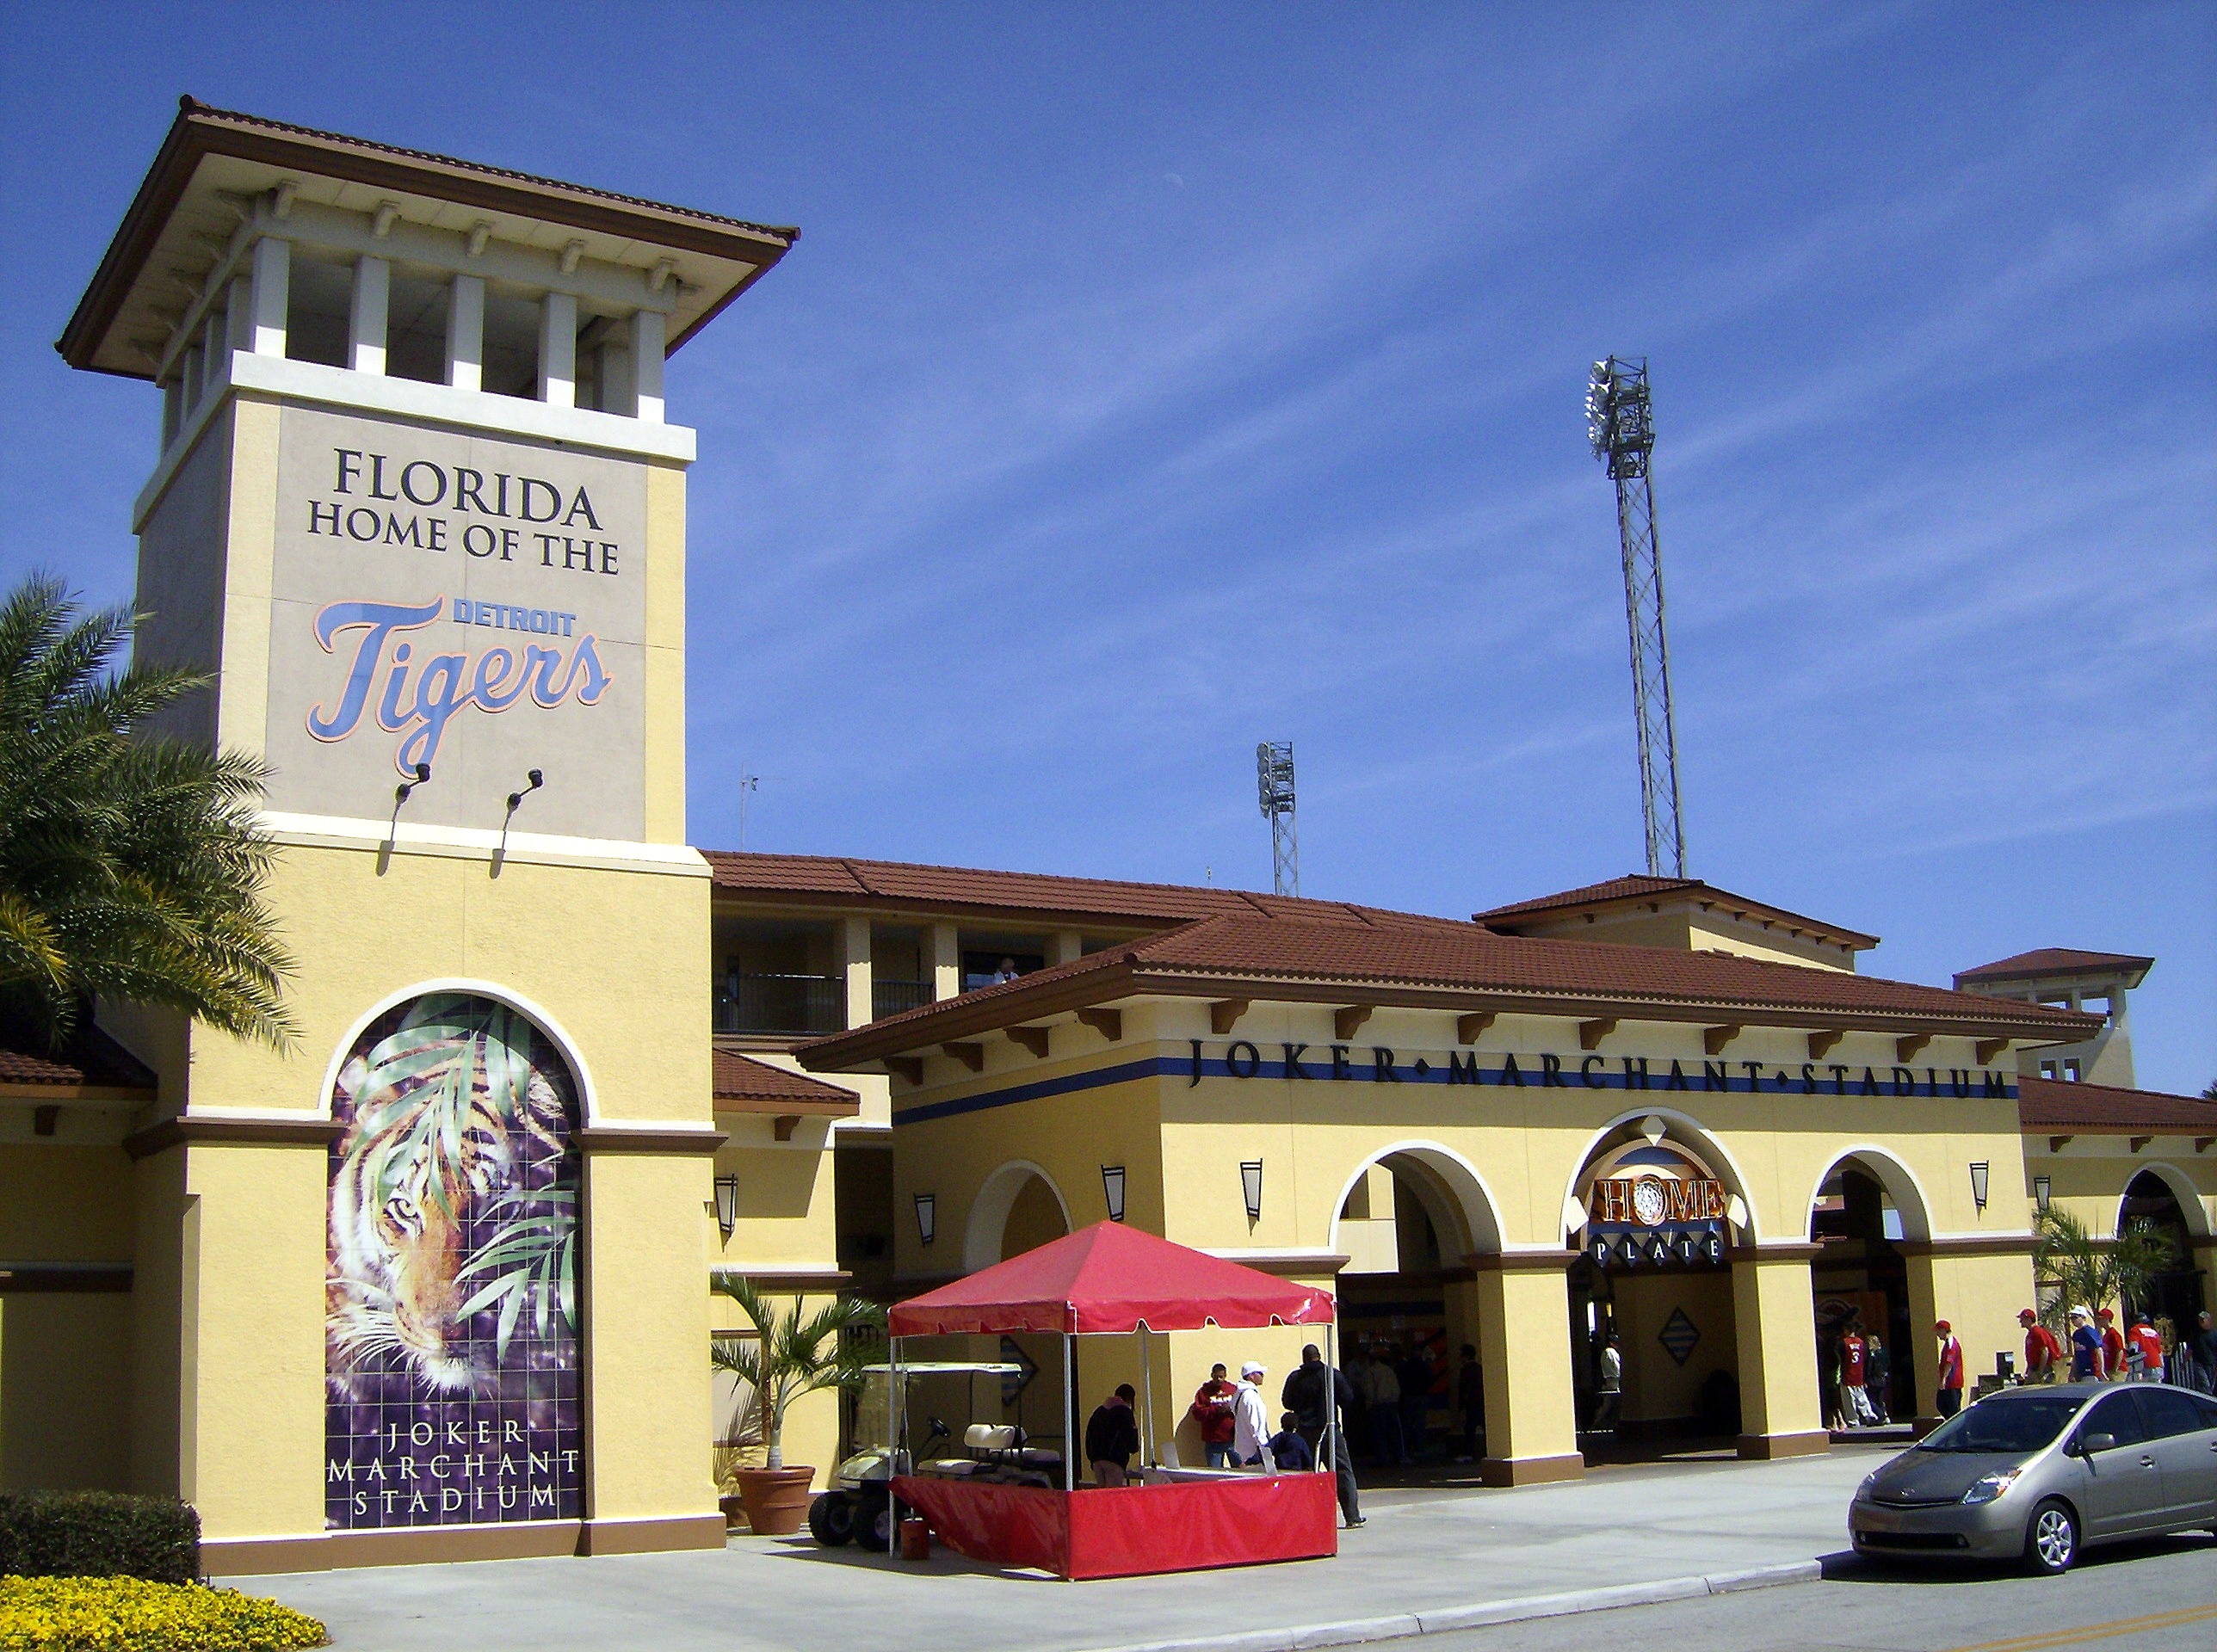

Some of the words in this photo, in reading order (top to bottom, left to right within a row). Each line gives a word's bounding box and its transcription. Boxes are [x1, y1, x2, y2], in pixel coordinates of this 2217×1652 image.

[333, 448, 603, 531] FLORIDA
[307, 500, 447, 552] HOME
[462, 524, 519, 561] OF
[534, 533, 620, 575] THE
[453, 598, 577, 638] DETROIT
[306, 592, 614, 780] Tigers
[1189, 1039, 1402, 1088] JOKER
[1448, 1050, 1764, 1094] MARCHANT
[1801, 1063, 2010, 1100] STADIUM
[1603, 1173, 1726, 1227] HOME
[1596, 1239, 1719, 1261] PLATE
[1851, 1351, 1860, 1364] 3
[387, 1420, 524, 1453] JOKER
[327, 1450, 579, 1482] MARCHANT
[354, 1483, 556, 1516] STADIUM
